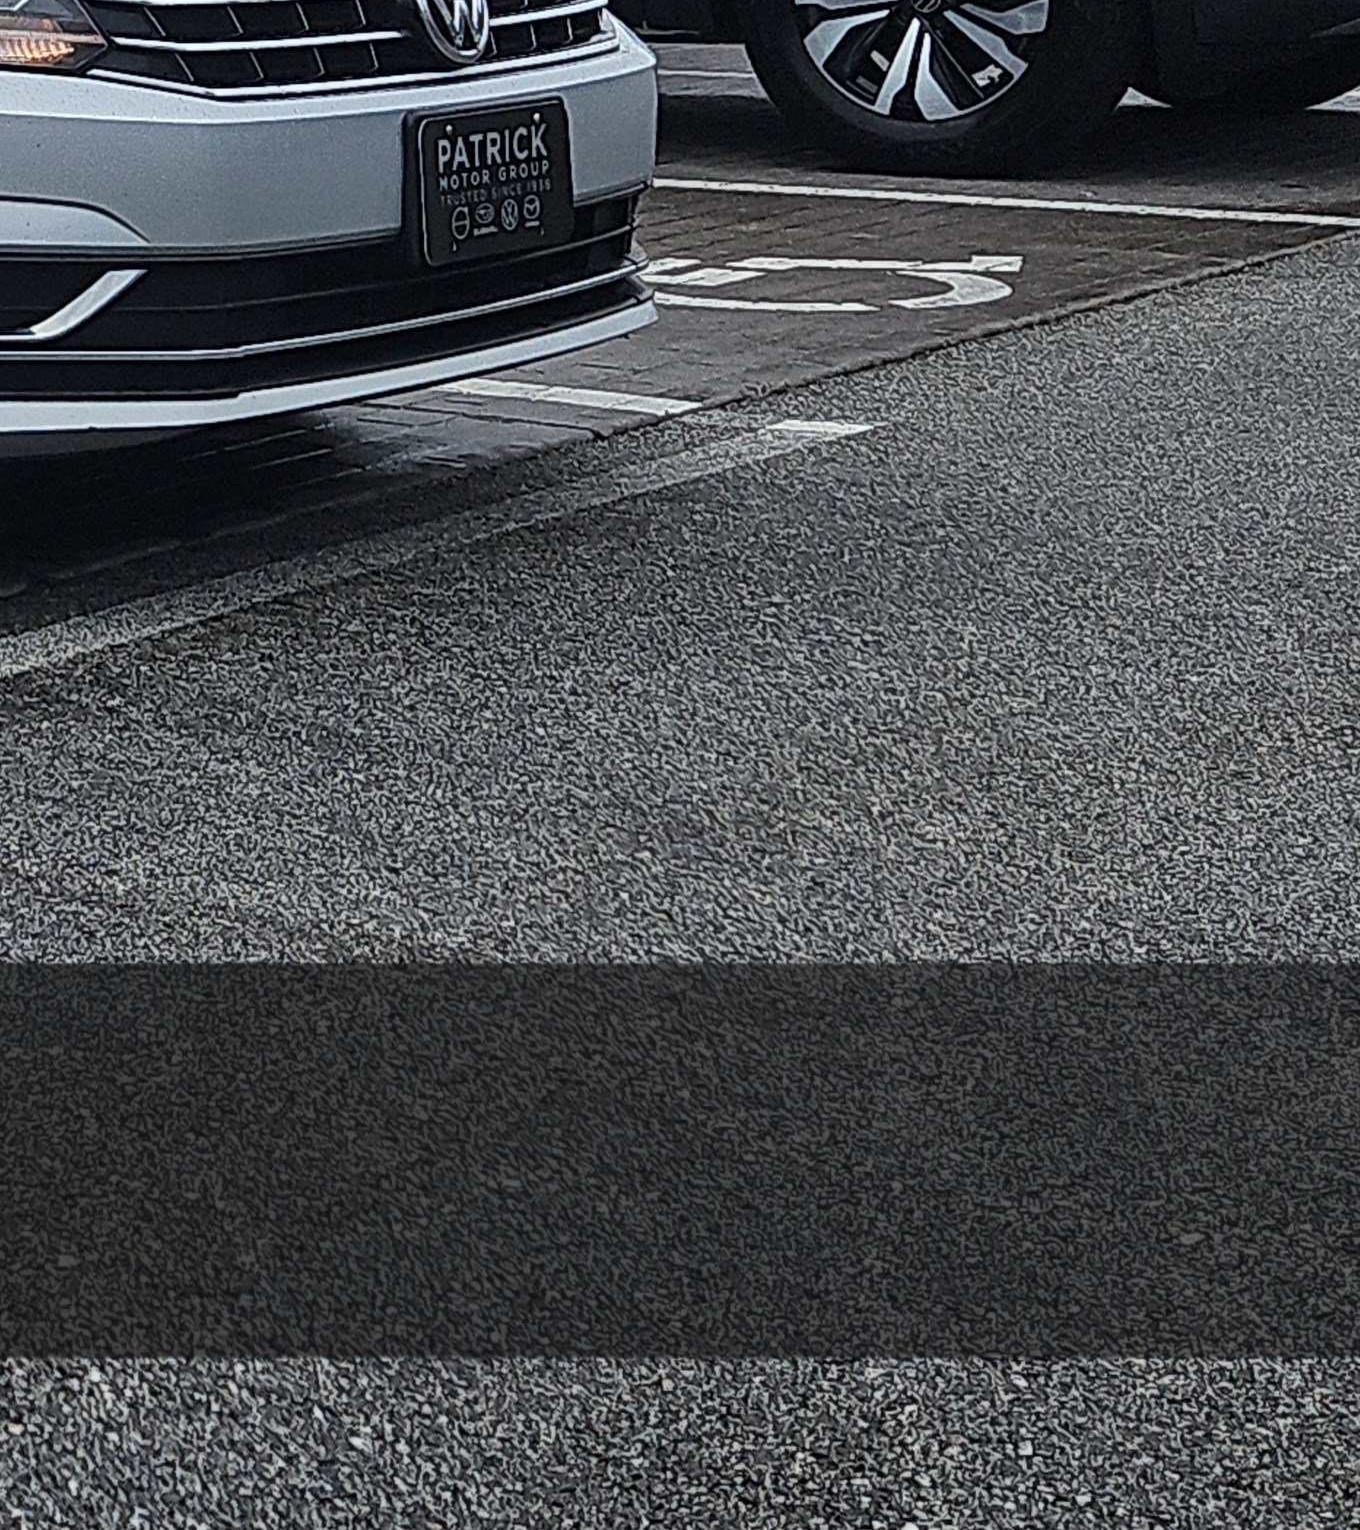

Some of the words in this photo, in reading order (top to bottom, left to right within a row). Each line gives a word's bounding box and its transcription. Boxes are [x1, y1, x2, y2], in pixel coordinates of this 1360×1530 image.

[436, 122, 549, 174] PATRICK
[438, 169, 491, 192] MOTOR
[498, 160, 551, 182] GROUP
